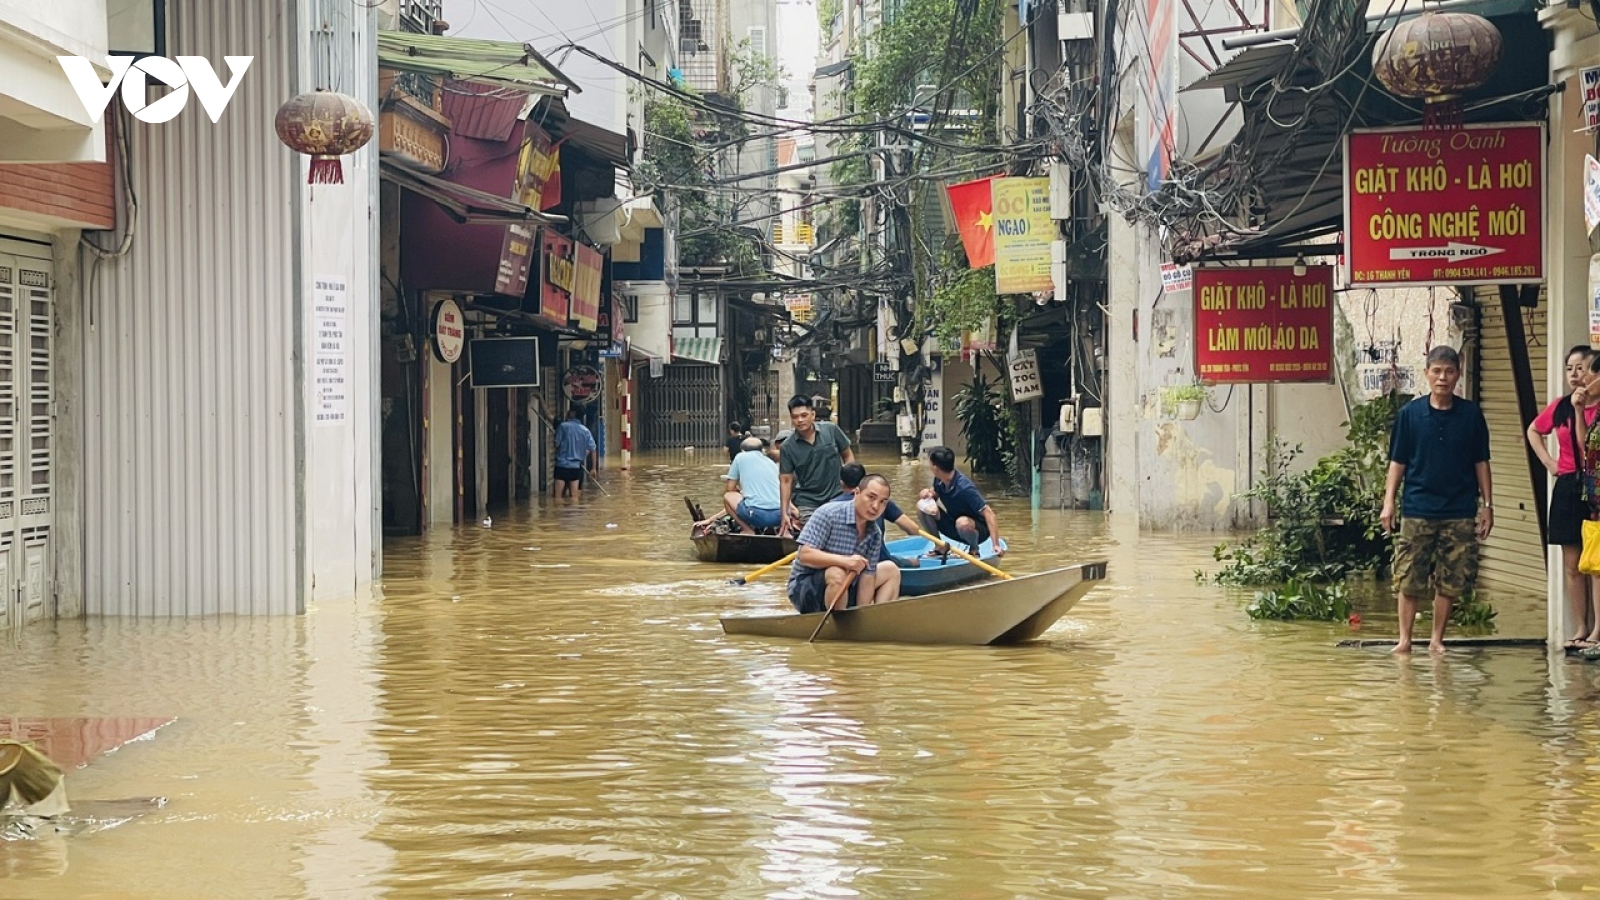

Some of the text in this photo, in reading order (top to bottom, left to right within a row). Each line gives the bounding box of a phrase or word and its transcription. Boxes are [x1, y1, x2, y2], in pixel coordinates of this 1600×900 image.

[1450, 130, 1506, 150] Oanh
[1355, 163, 1399, 200] GIẶT
[1407, 159, 1447, 191] KHÔ
[1468, 158, 1492, 189] LÀ
[1500, 159, 1532, 188] HƠI
[997, 189, 1024, 215] ỐC
[998, 219, 1026, 236] NGAO
[1369, 203, 1526, 242] CÔNG NGHỆ MỚI
[1410, 250, 1456, 258] TRONG
[1201, 281, 1233, 315] GIẶT
[1237, 280, 1265, 310] KHÔ
[1280, 280, 1297, 309] LÀ
[1302, 282, 1326, 308] HƠI
[1209, 322, 1319, 351] LÀM MỚI ÁO DA
[1015, 384, 1040, 395] NAM
